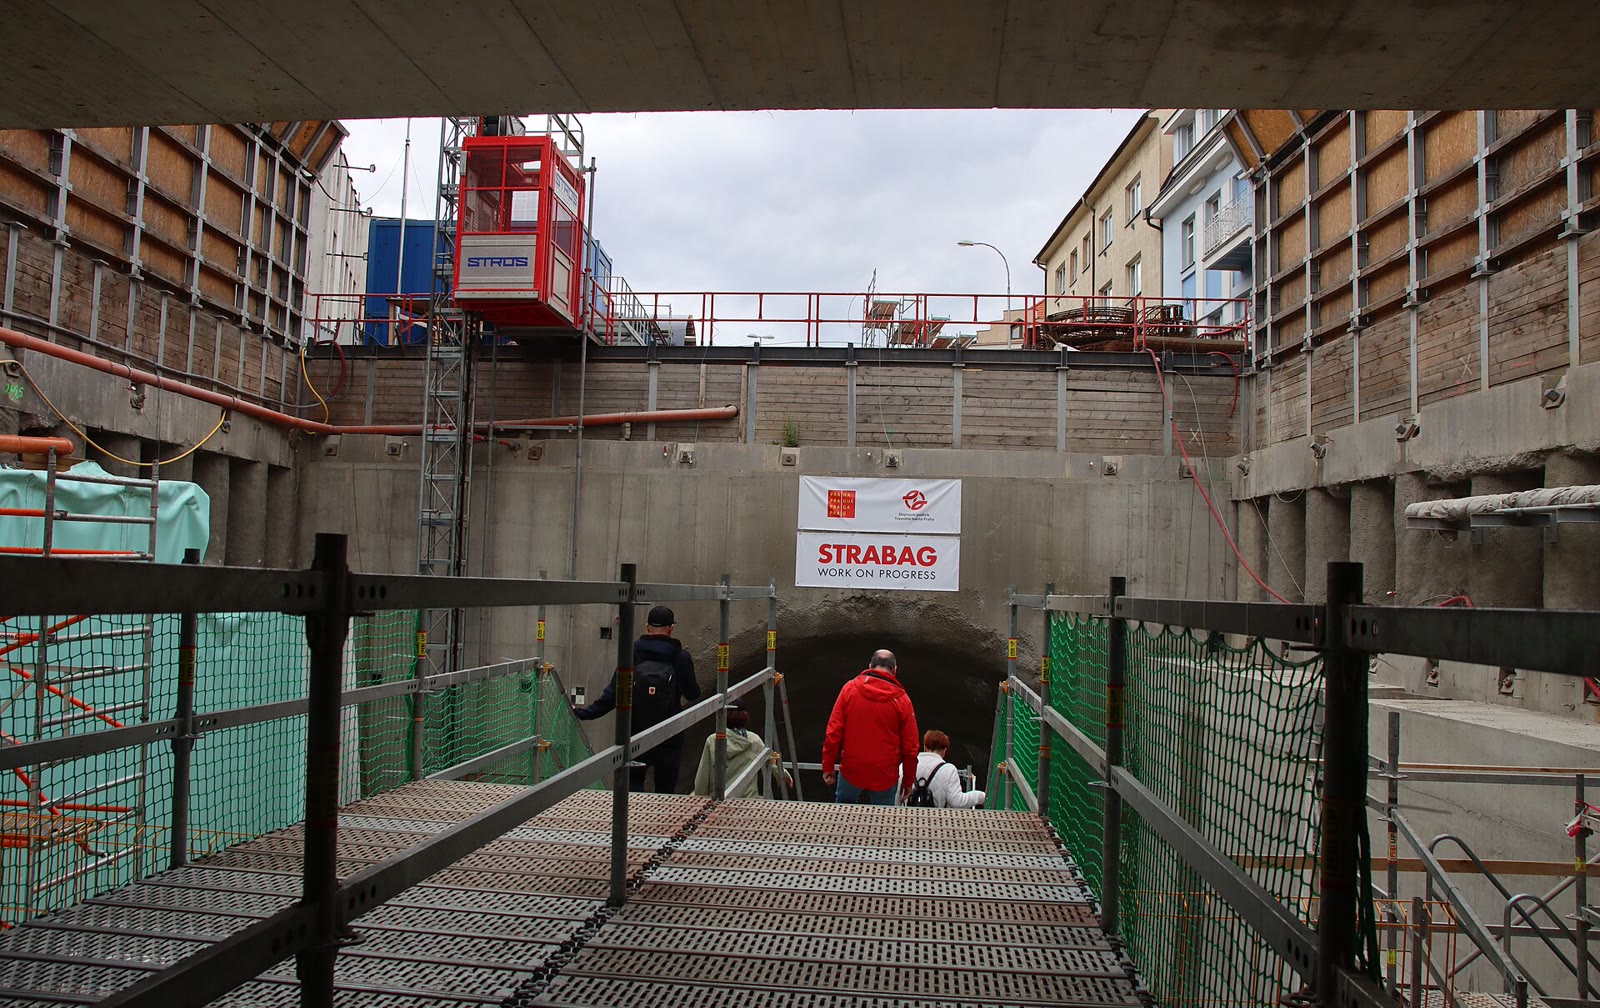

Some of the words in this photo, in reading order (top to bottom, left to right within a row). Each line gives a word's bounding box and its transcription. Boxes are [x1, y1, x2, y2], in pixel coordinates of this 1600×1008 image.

[468, 257, 528, 267] STROS
[818, 543, 938, 567] STRABAG
[818, 568, 852, 578] WORK
[855, 568, 874, 578] ON
[879, 569, 937, 580] PROGRESS
